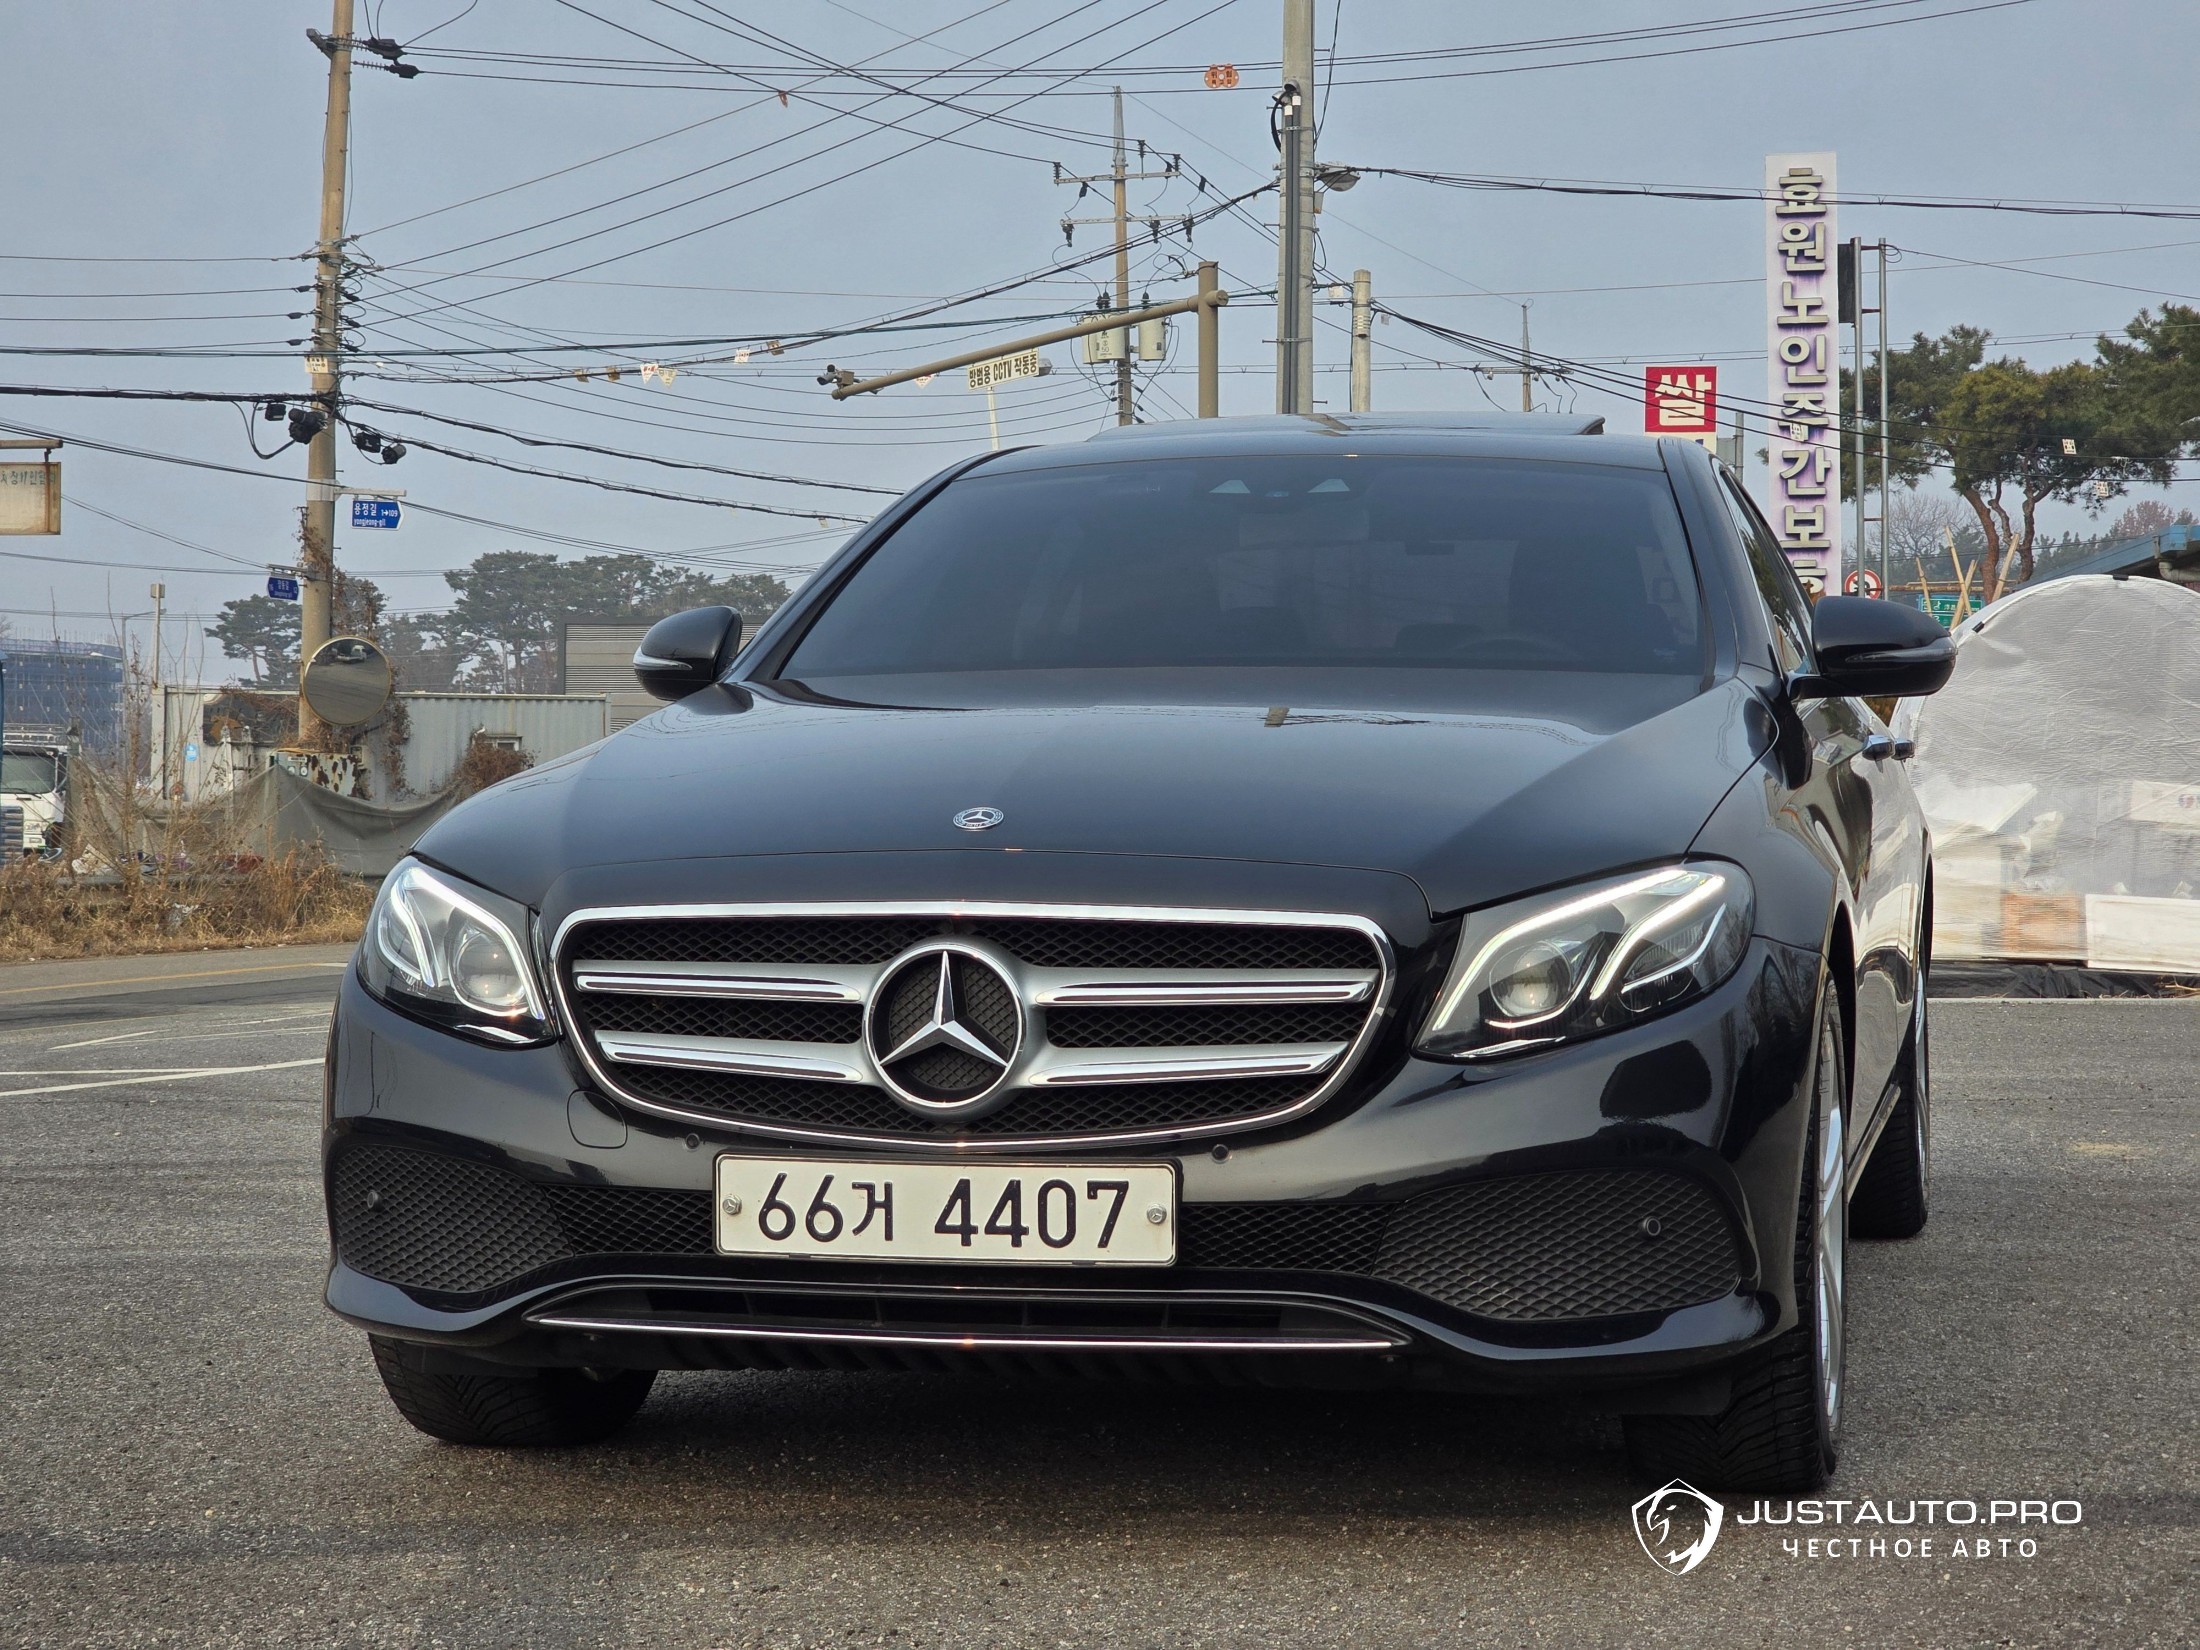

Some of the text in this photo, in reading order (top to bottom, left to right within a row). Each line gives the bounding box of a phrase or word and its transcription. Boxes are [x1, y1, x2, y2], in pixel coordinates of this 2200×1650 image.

[969, 353, 1037, 388] 방범용 CCTV 작동중
[1655, 374, 1712, 426] 쌀
[354, 502, 377, 517] 용정길
[758, 1172, 1130, 1248] 66거 4407
